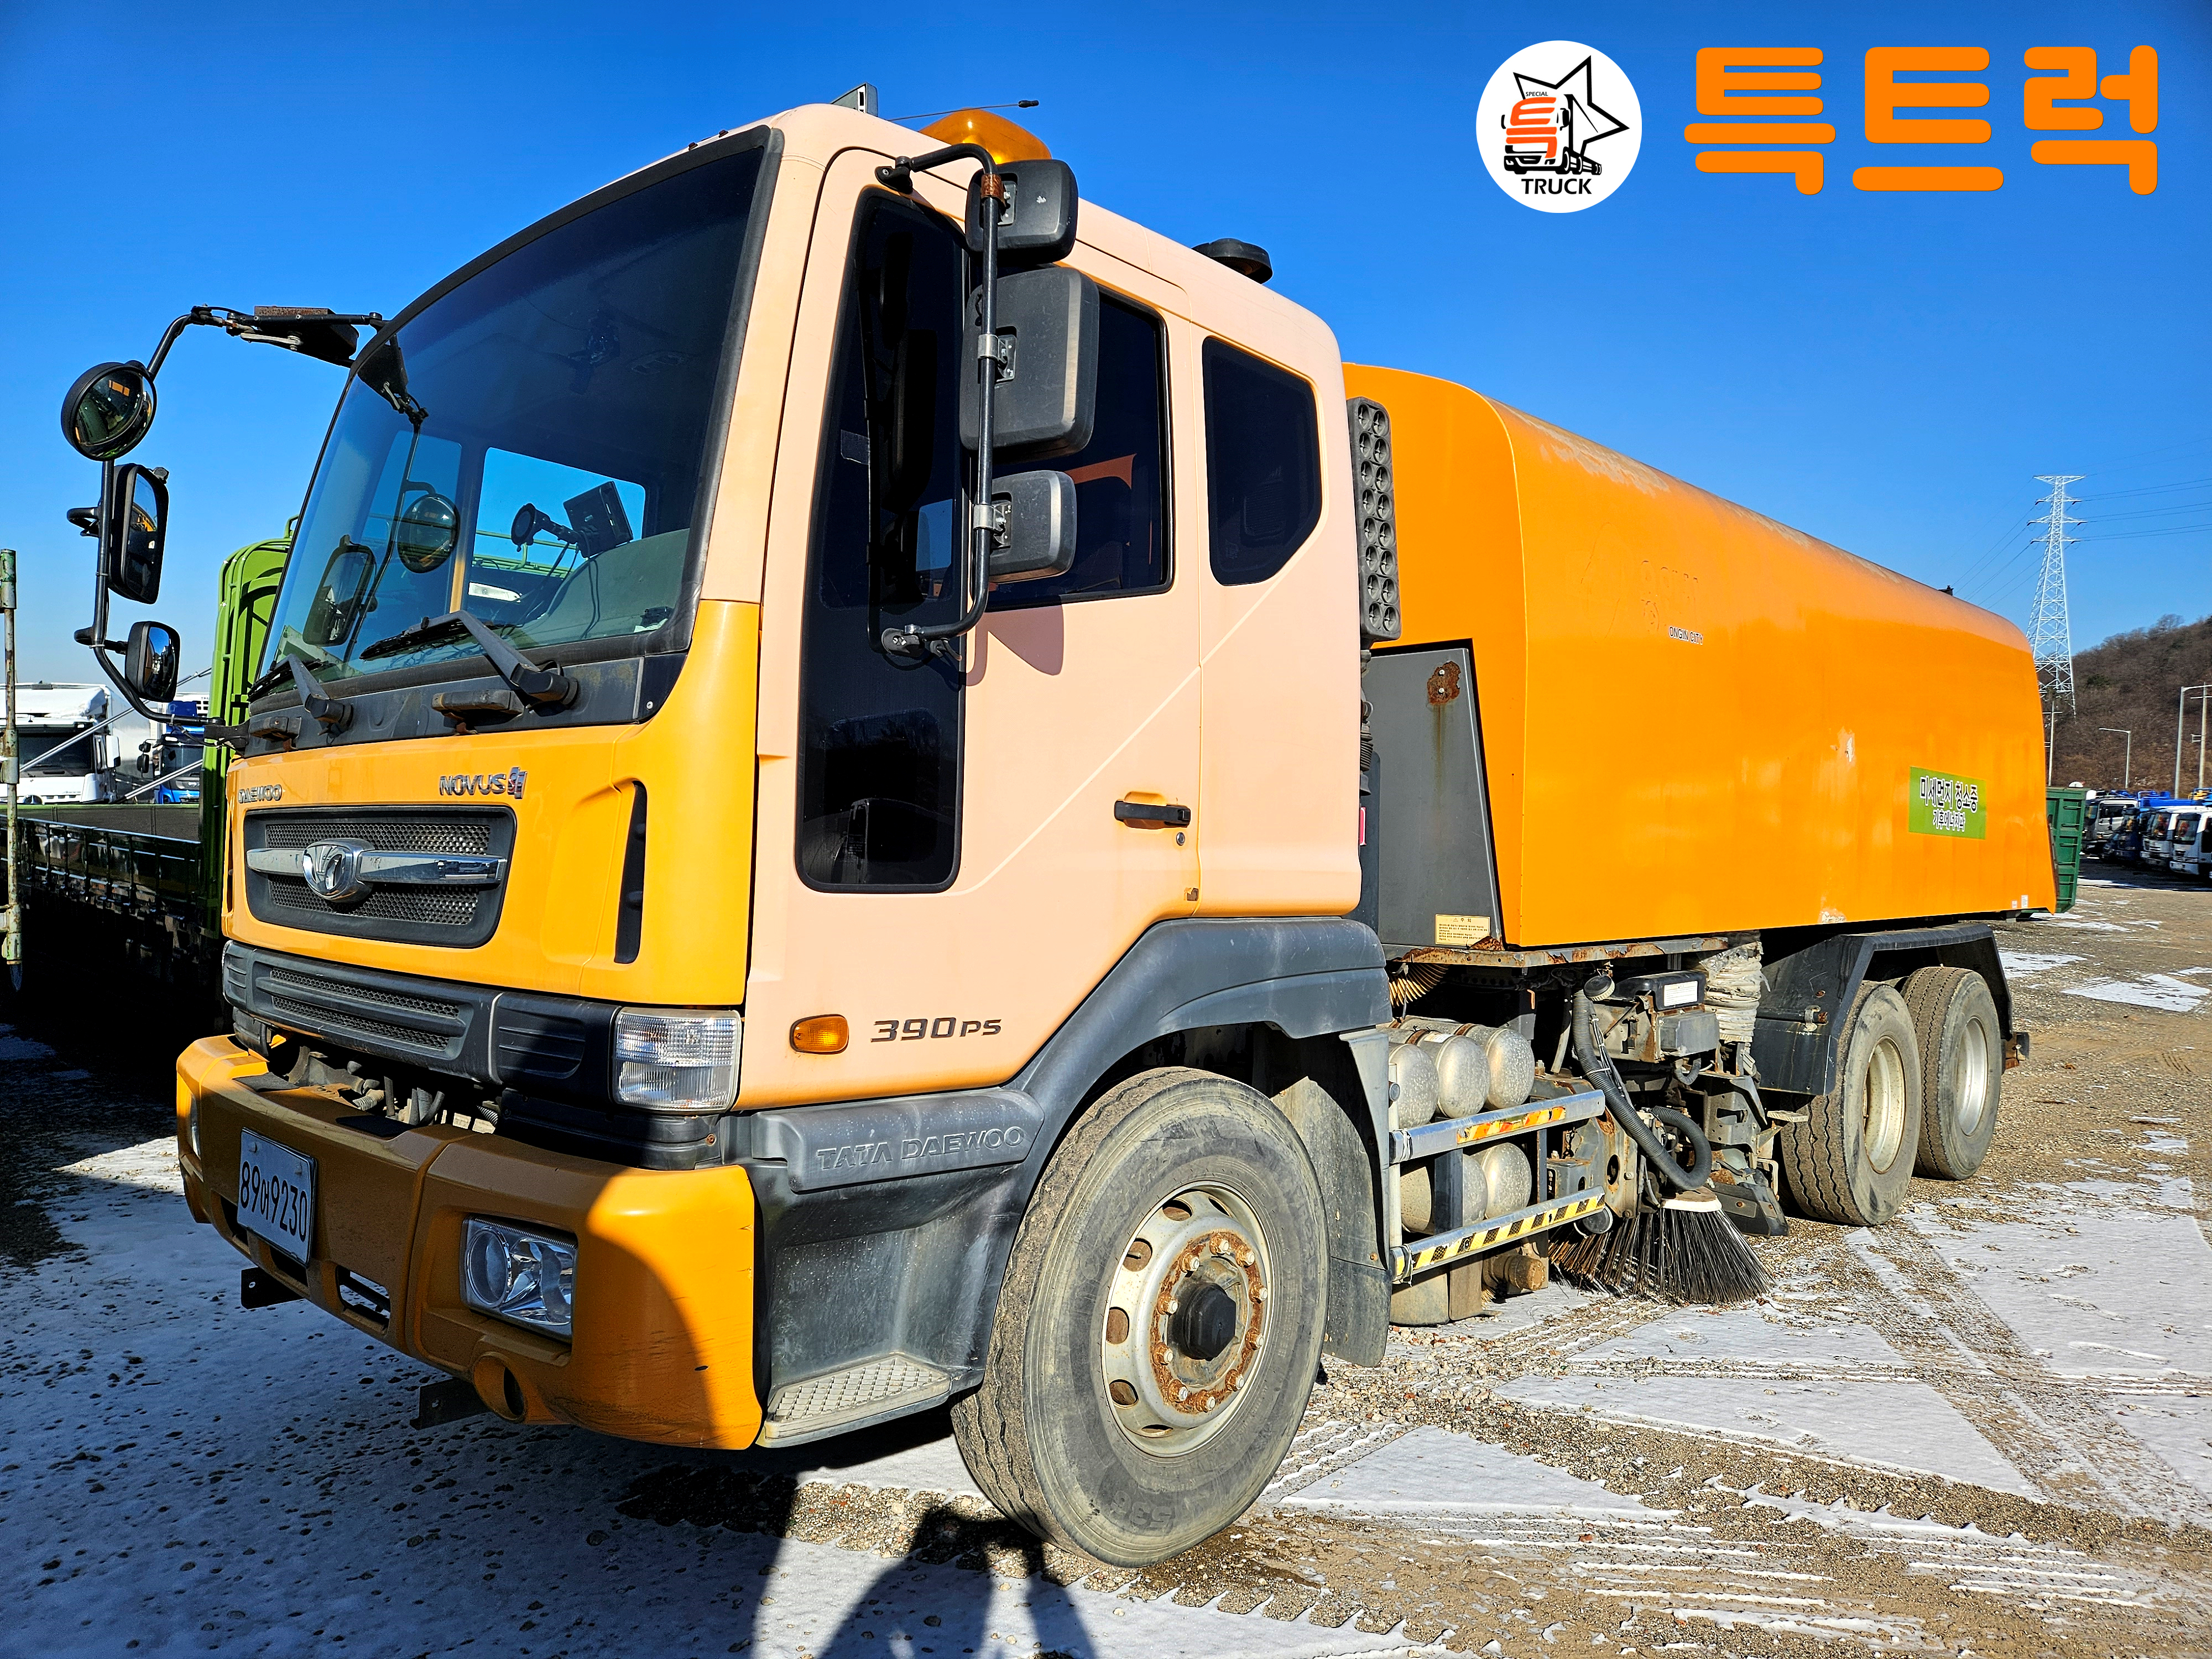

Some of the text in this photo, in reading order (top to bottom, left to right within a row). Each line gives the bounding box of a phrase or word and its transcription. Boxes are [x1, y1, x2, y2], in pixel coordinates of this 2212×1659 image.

[1689, 631, 1703, 645] CITY
[238, 784, 283, 804] DAEWOO
[440, 774, 507, 796] NOVUS
[1919, 775, 1979, 813] 미세먼지 청소중
[817, 1125, 1025, 1170] TATA DAEWOO
[241, 1161, 307, 1241] 89어9230
